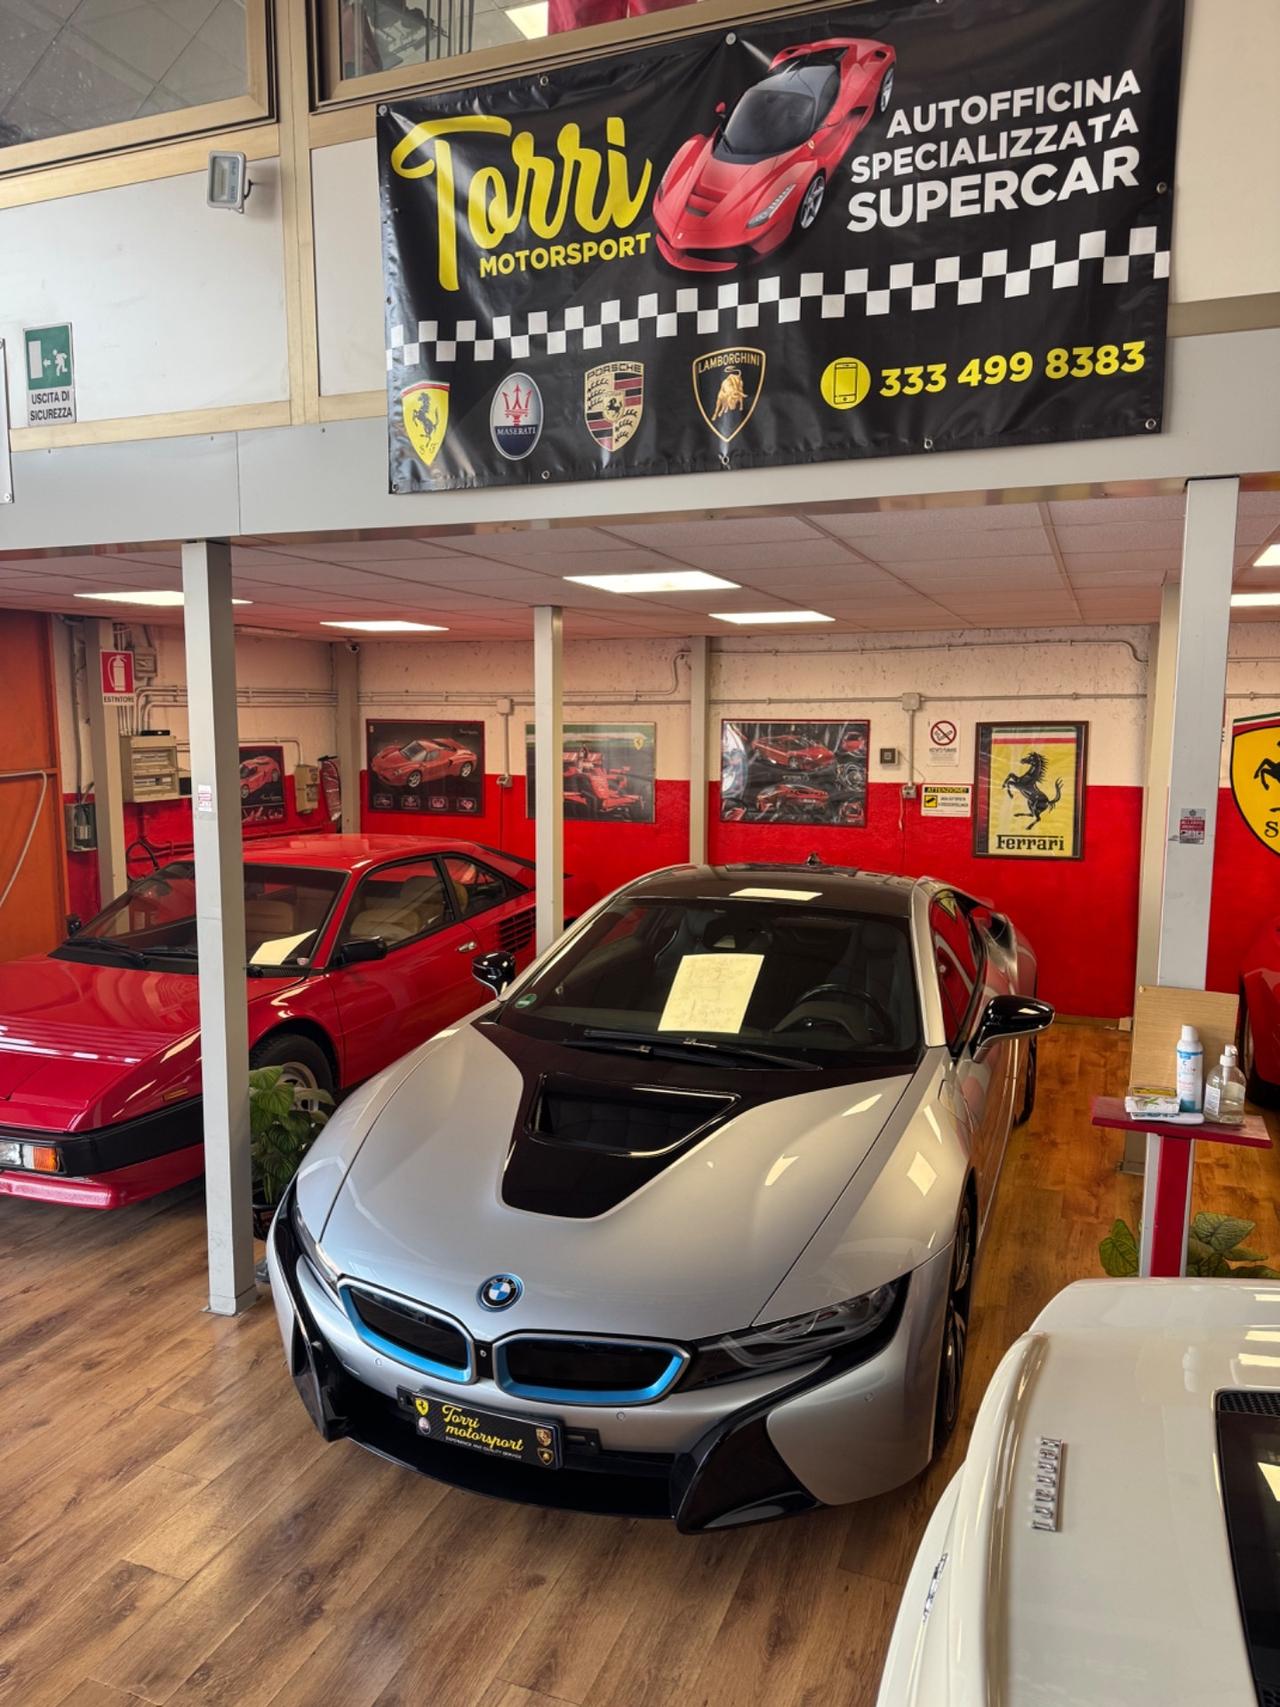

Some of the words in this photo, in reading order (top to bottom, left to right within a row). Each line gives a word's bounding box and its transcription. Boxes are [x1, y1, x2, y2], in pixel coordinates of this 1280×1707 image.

[886, 69, 1141, 139] AUTOFFICINA
[850, 107, 1139, 184] SPECIALIZZATA
[846, 145, 1140, 233] SUPERCAR
[391, 115, 653, 292] Torri
[479, 232, 651, 278] MOTORSPORT
[586, 363, 641, 380] PORSCHE
[698, 352, 760, 374] LAMBORGHINI
[879, 363, 947, 397] 333
[957, 351, 1034, 387] 499
[1045, 340, 1145, 379] 8383
[31, 392, 59, 404] USCITA
[61, 391, 70, 401] DI
[30, 407, 73, 421] SICUREZZA
[496, 427, 536, 436] MASERATI
[103, 695, 134, 703] ESTINTORE
[1264, 820, 1279, 838] S
[996, 834, 1064, 851] Ferrari
[442, 1404, 480, 1429] Torri
[445, 1425, 524, 1451] motorsport
[1032, 1436, 1062, 1532] Ferrari
